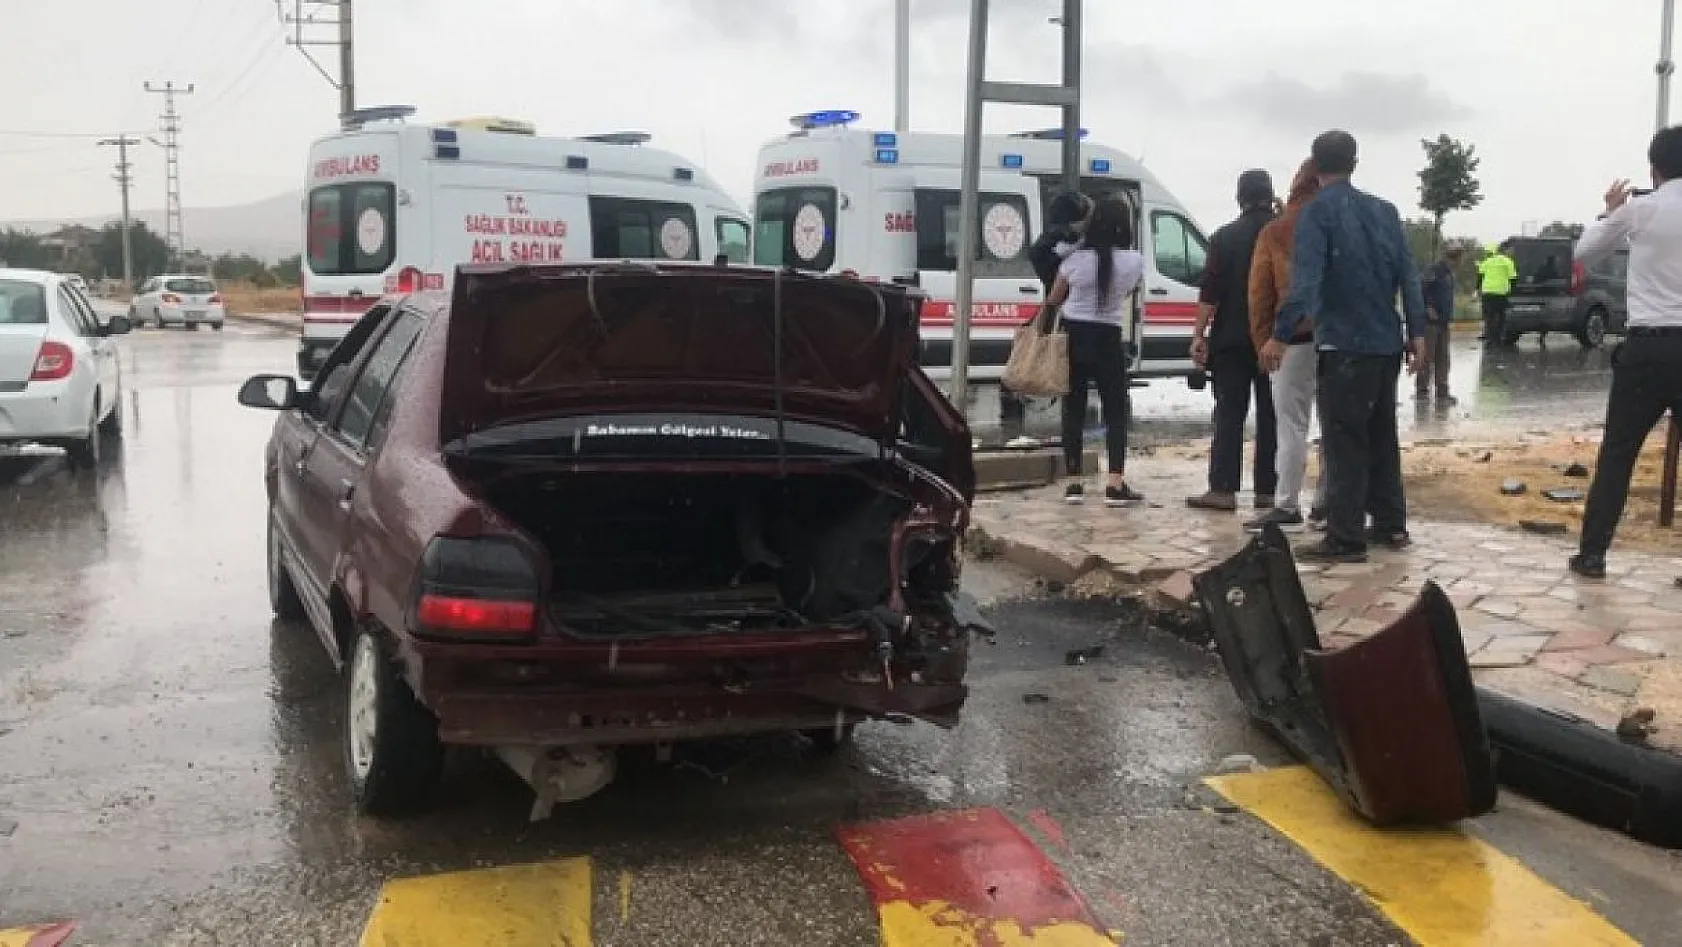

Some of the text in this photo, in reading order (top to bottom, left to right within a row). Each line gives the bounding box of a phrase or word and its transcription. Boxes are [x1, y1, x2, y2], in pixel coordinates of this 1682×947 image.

[313, 154, 381, 178] AMBULANS
[465, 213, 568, 237] SAĞLIK BAKANLIĞI
[510, 240, 563, 262] SAĞLIK
